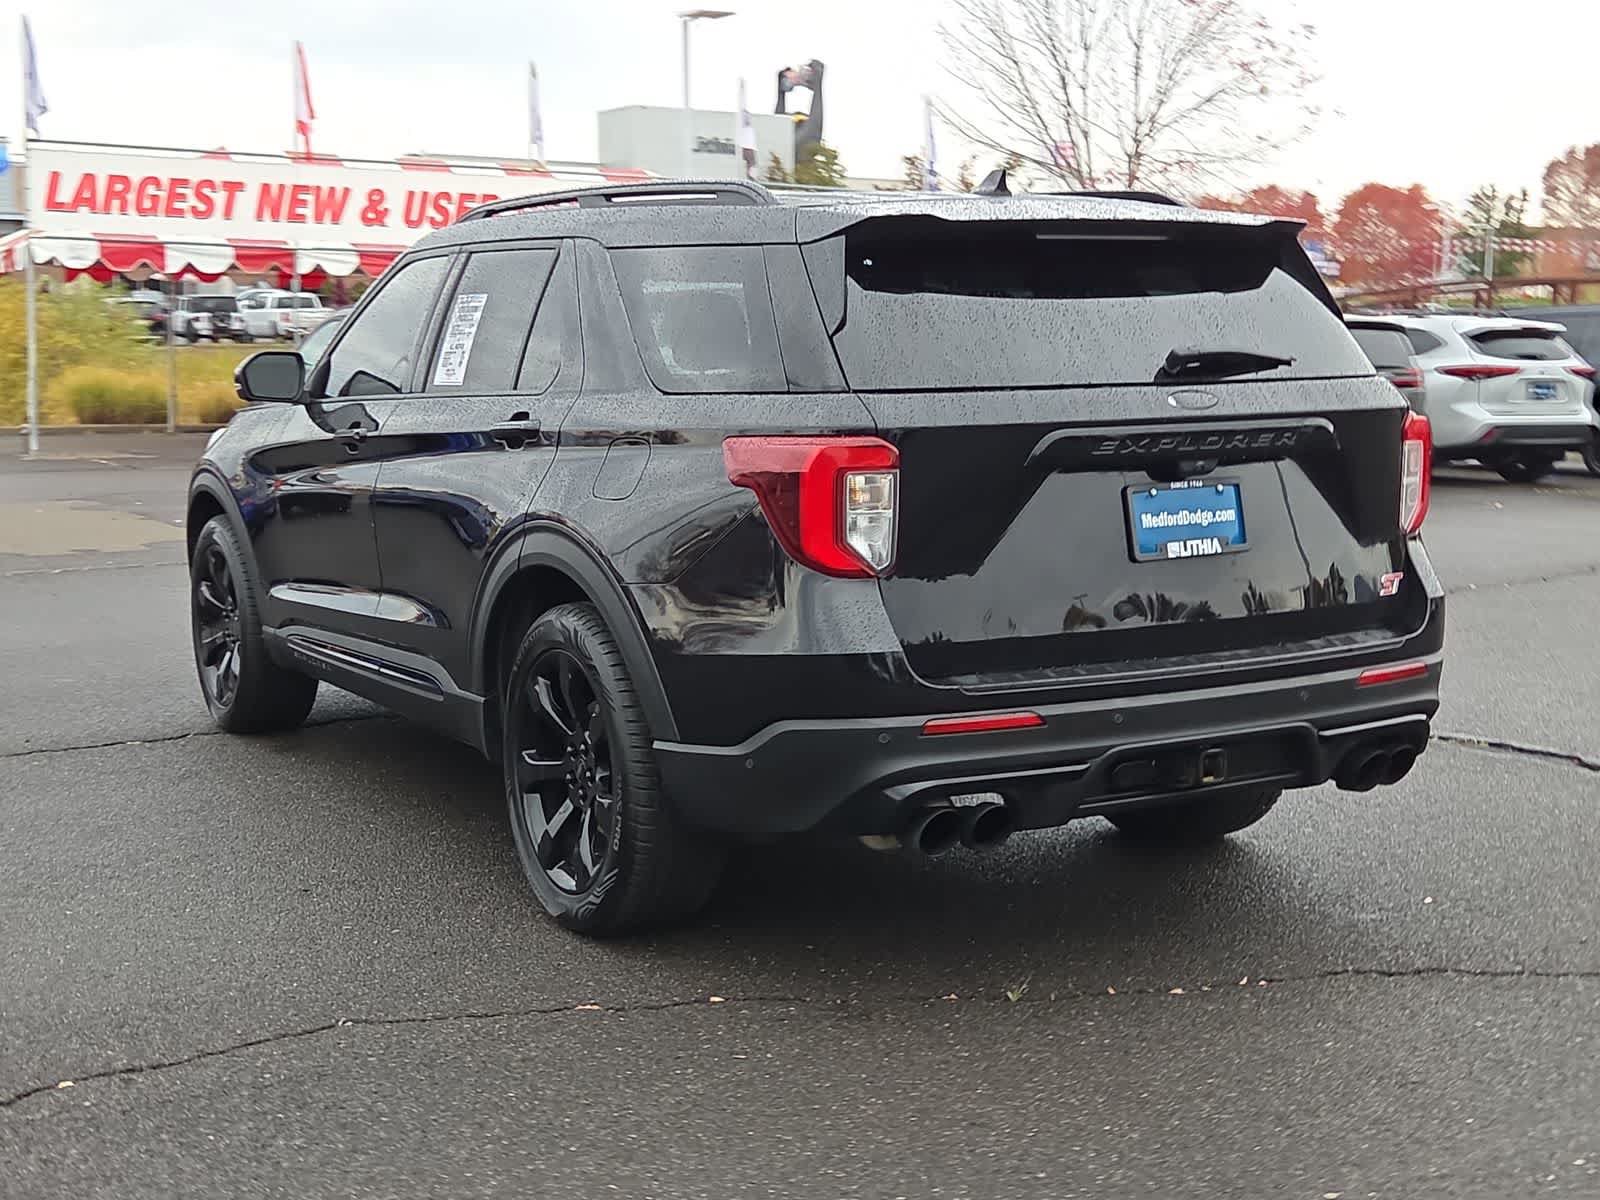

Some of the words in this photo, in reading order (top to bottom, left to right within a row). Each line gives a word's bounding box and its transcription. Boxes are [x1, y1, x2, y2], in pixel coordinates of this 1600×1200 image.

[46, 170, 245, 220] LARGEST
[257, 182, 350, 225] NEW
[361, 188, 390, 228] &
[1092, 432, 1298, 455] EXPLORER
[1141, 508, 1236, 529] MedfordDodge.com
[1180, 538, 1221, 556] LITHIA
